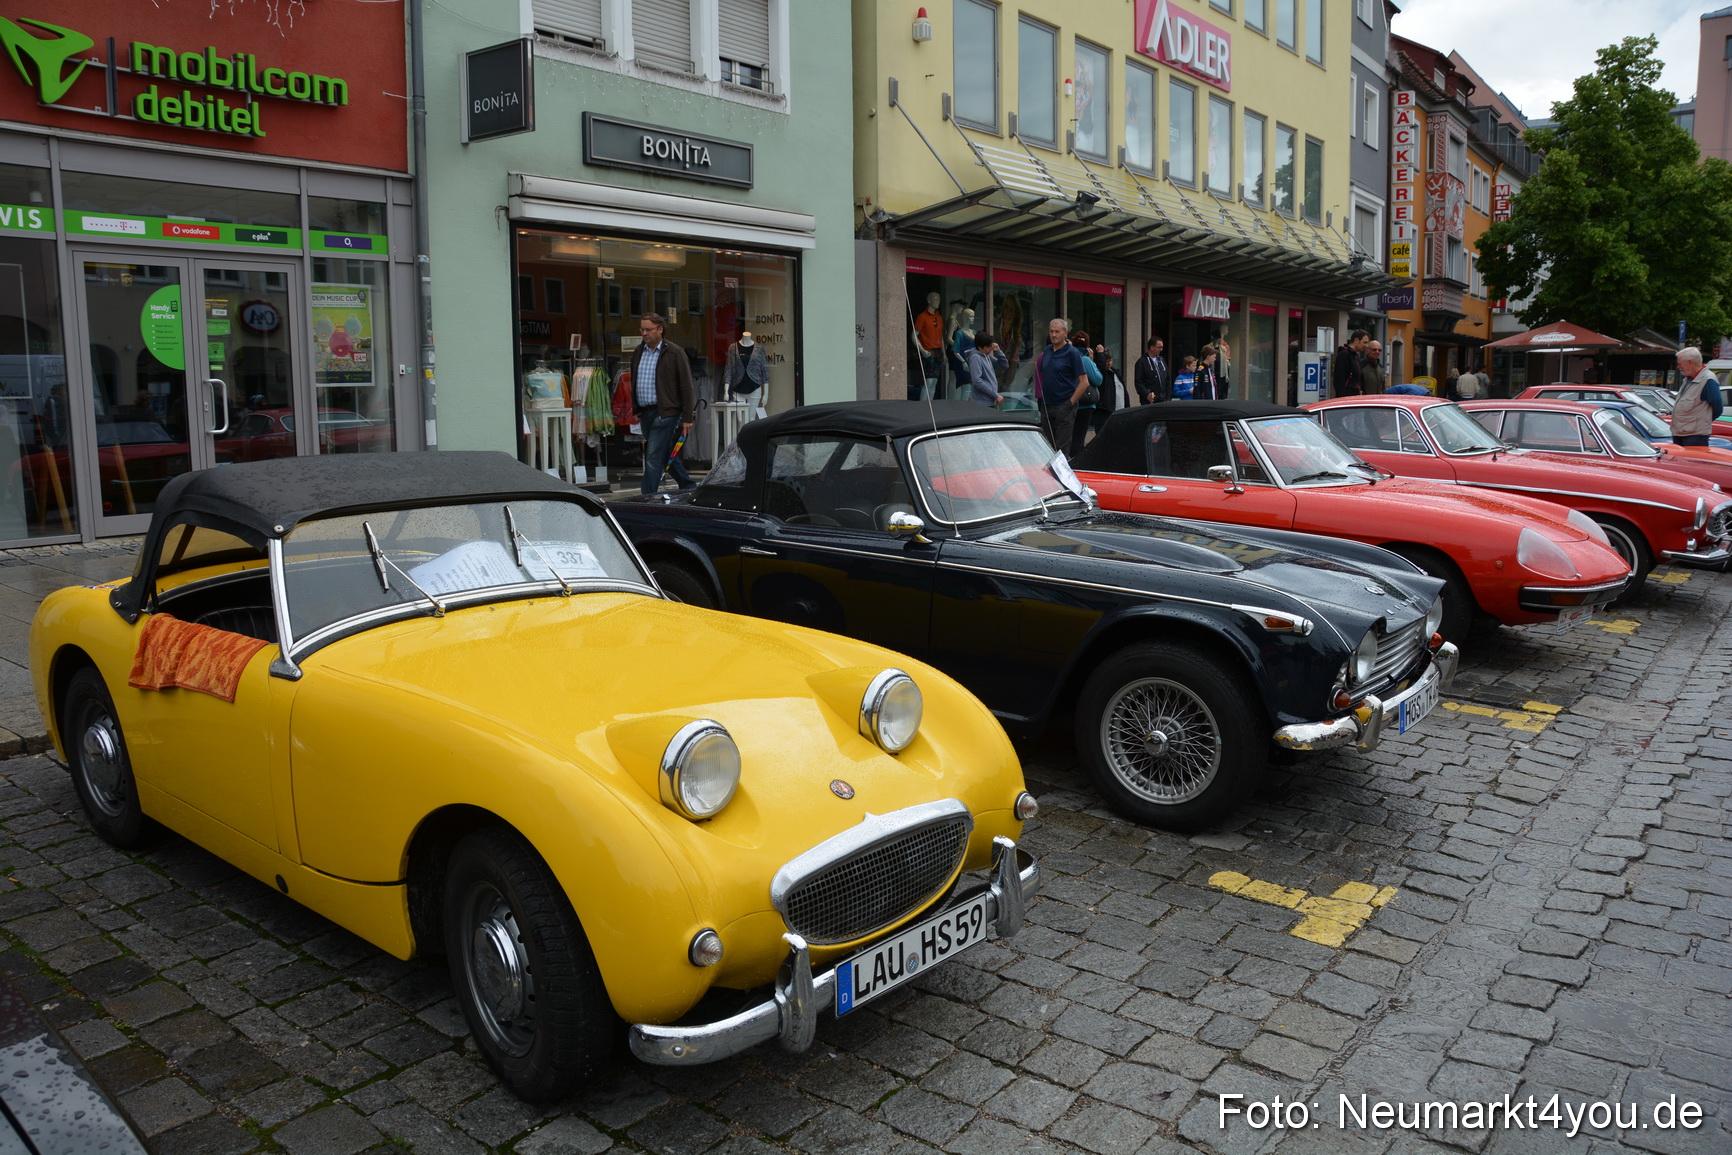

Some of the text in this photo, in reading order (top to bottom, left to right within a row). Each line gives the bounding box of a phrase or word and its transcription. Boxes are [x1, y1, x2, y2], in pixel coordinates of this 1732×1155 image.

[1146, 0, 1230, 83] ADLER
[131, 41, 349, 106] mobilcom
[474, 90, 519, 114] BONITA
[135, 84, 267, 137] debitel
[643, 136, 712, 169] BONITA
[1395, 92, 1410, 238] BÄCKEREI
[181, 228, 211, 236] vodafone
[1392, 245, 1410, 256] café
[1190, 288, 1231, 320] ADLER
[1381, 292, 1412, 306] liberty
[150, 304, 170, 313] Handy
[755, 312, 785, 325] BONITA
[756, 332, 786, 345] BONITA
[767, 352, 785, 365] NITA
[1307, 367, 1316, 380] P
[556, 550, 584, 566] 337
[854, 941, 904, 1001] LAU
[841, 992, 848, 1004] D
